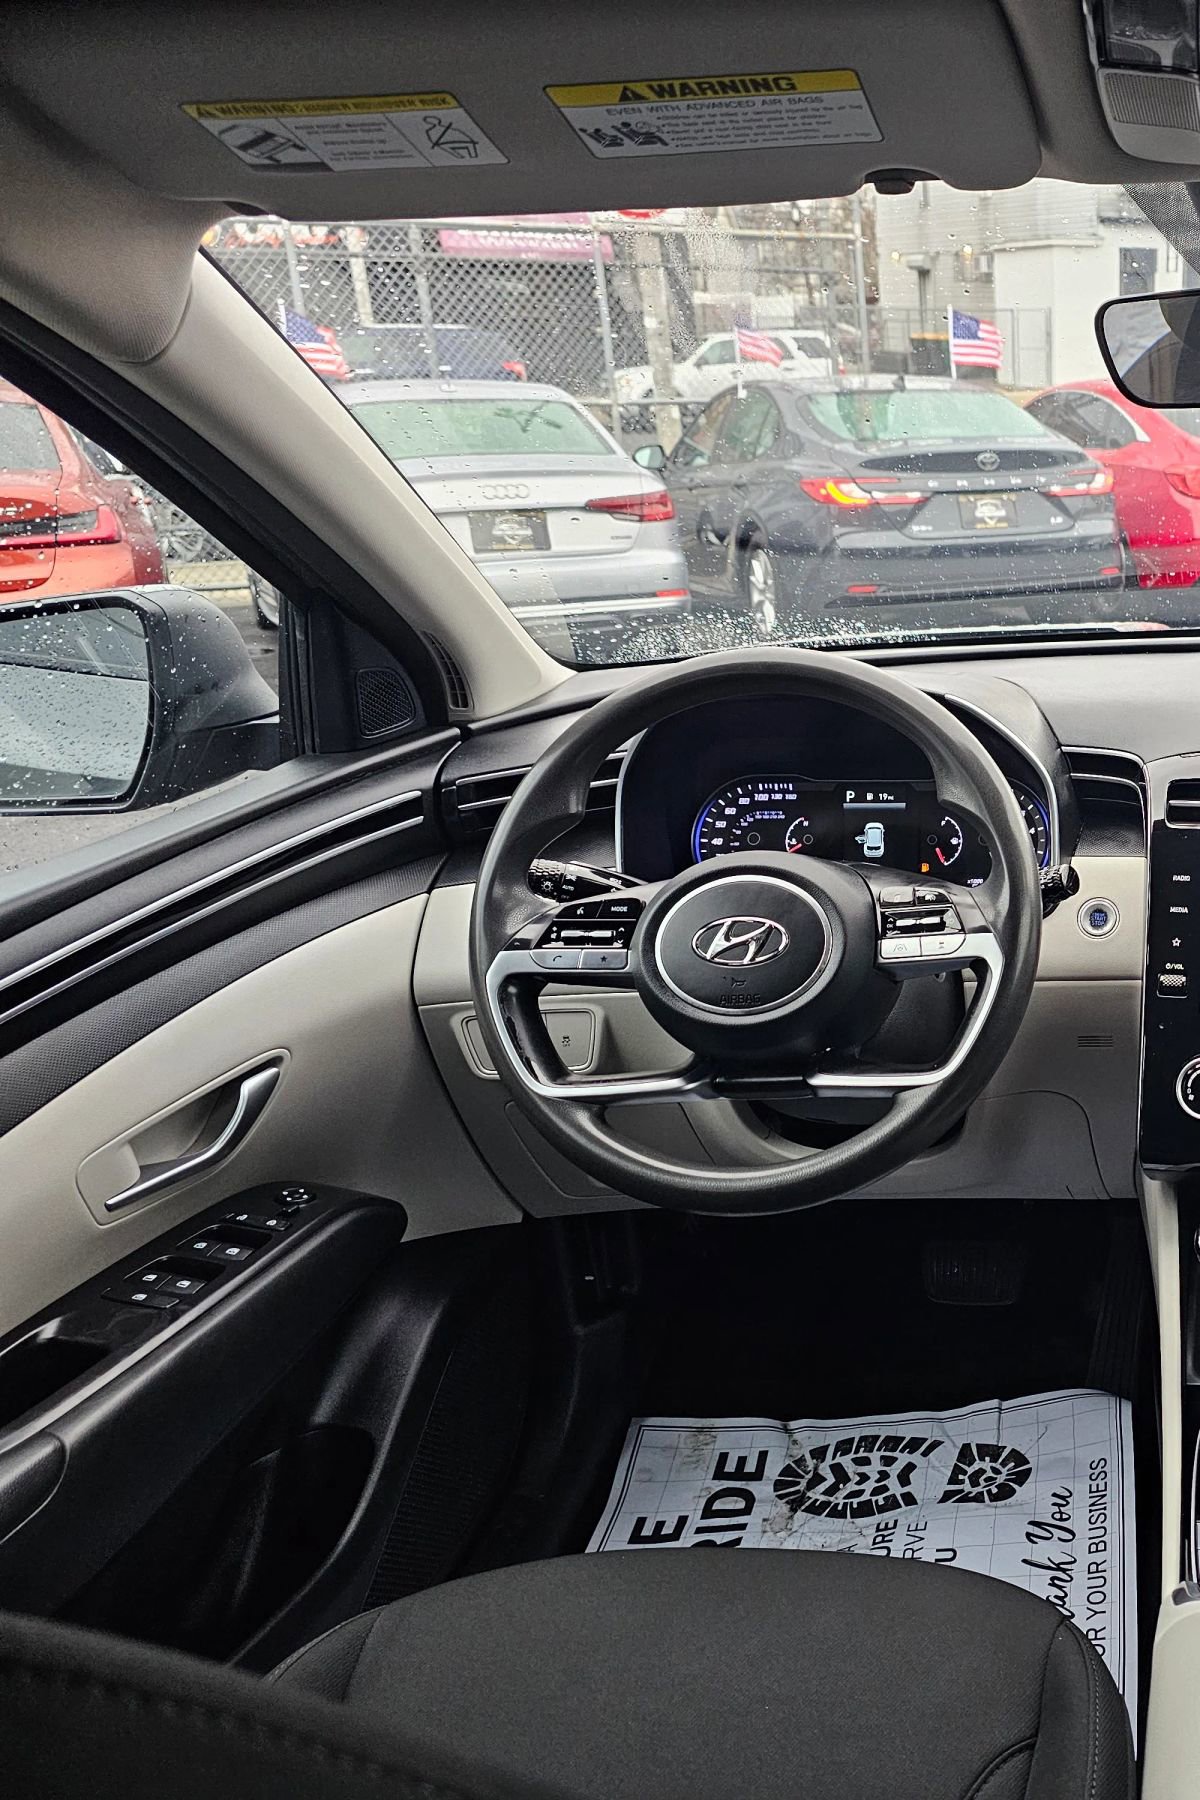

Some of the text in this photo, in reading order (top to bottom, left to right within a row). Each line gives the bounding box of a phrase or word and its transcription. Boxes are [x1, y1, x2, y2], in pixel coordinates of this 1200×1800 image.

[646, 77, 797, 99] WARNING
[605, 96, 825, 116] EVEN WITH ADVANCED AIR BAGS
[846, 791, 855, 802] P
[721, 993, 761, 1006] AIRBAG
[1025, 1486, 1076, 1545] You
[1087, 1457, 1108, 1554] BUSINESS
[1086, 1560, 1107, 1621] YOUR
